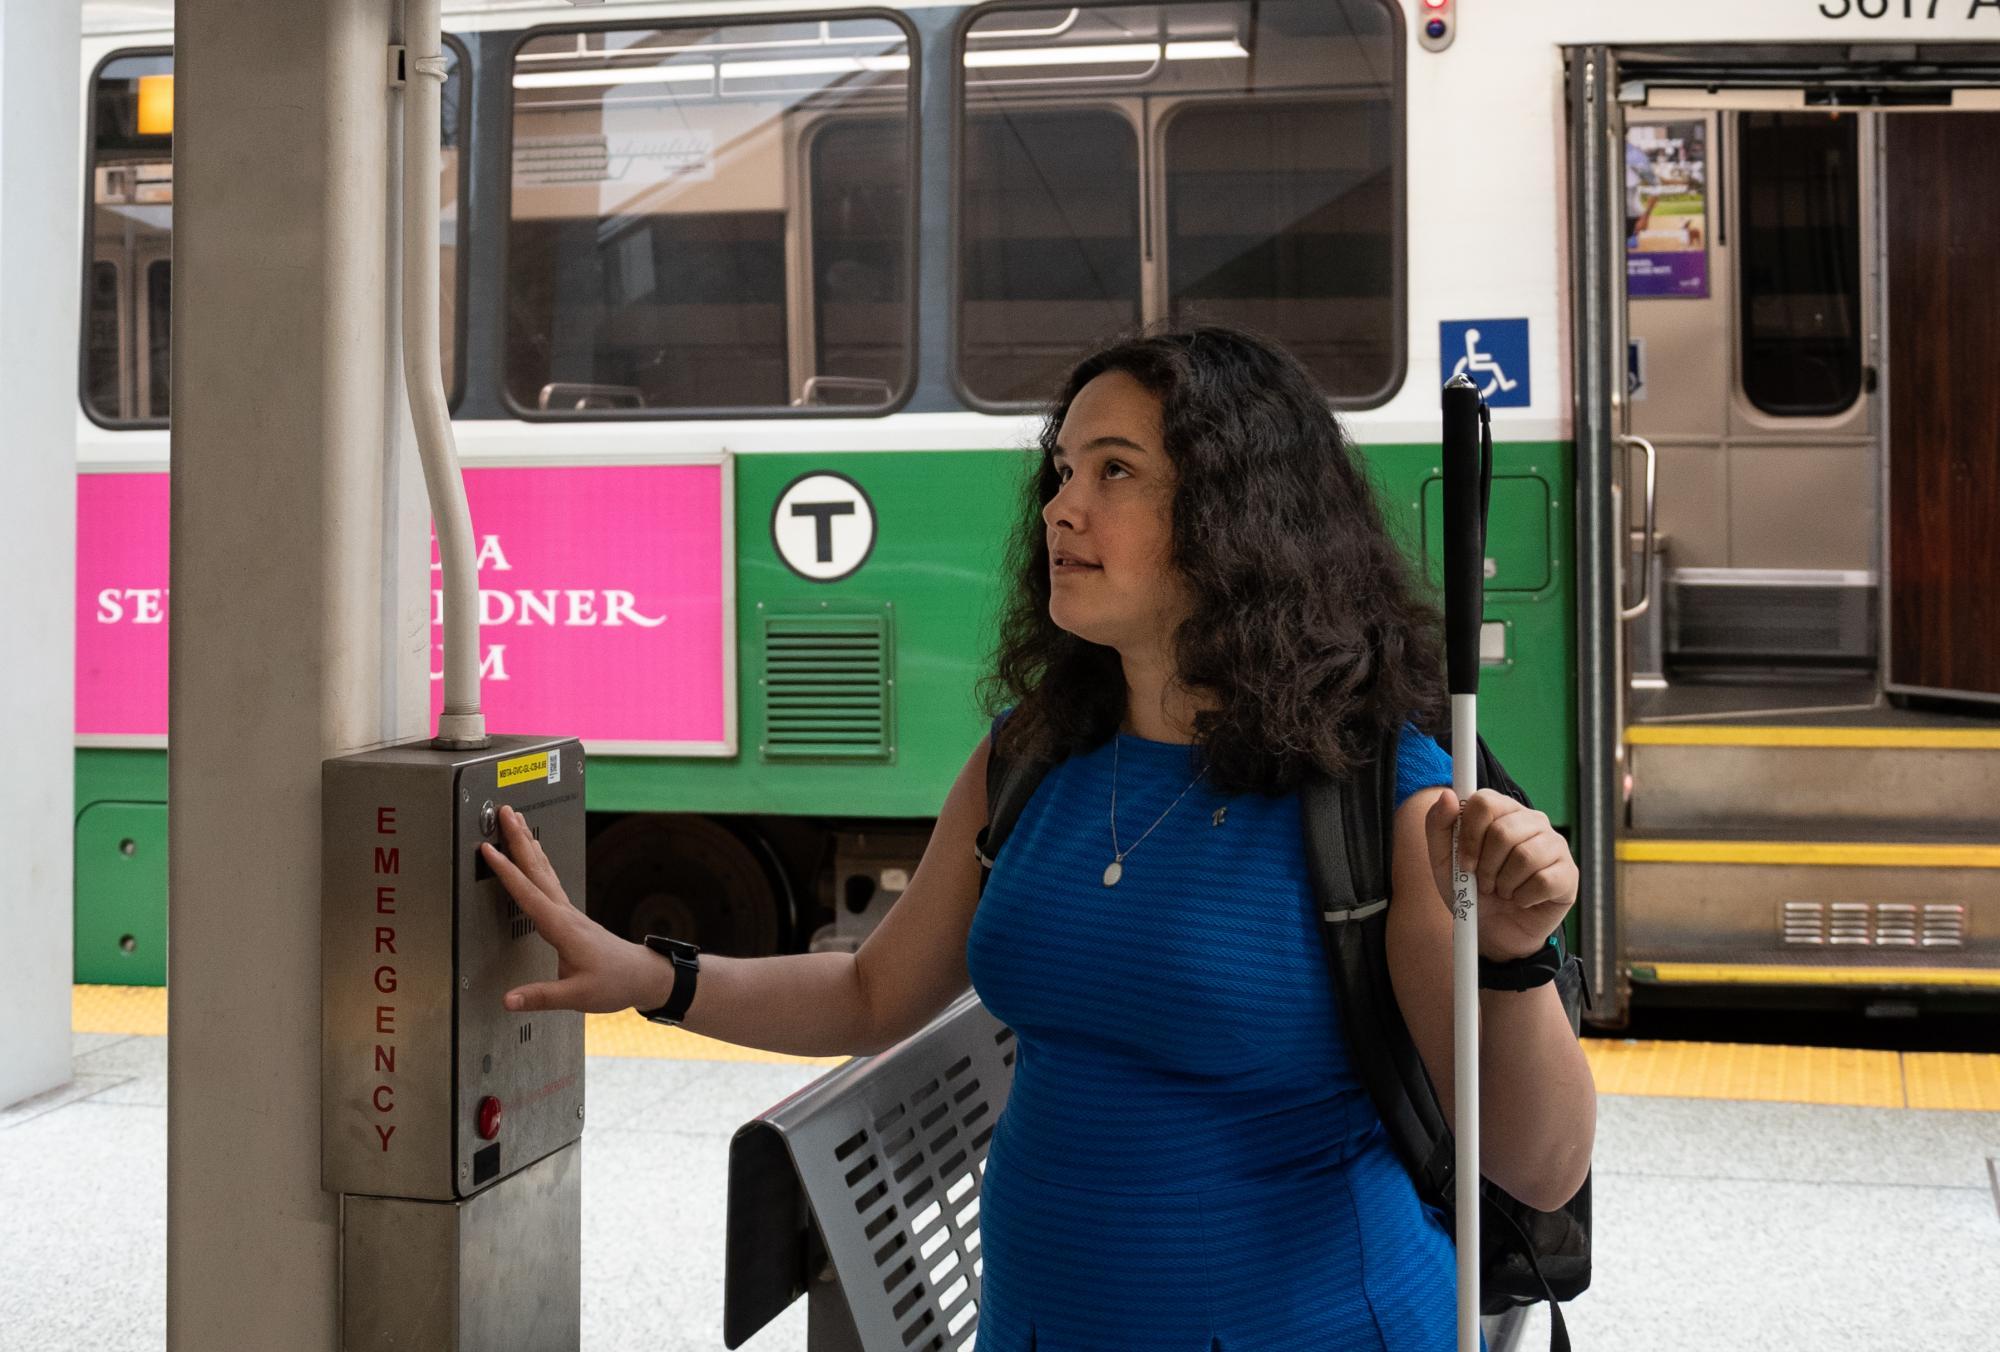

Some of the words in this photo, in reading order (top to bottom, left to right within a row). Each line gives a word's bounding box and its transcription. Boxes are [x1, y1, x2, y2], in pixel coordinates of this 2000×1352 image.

[791, 501, 855, 562] T
[97, 588, 169, 624] STE
[373, 807, 400, 1152] EMERGENCY
